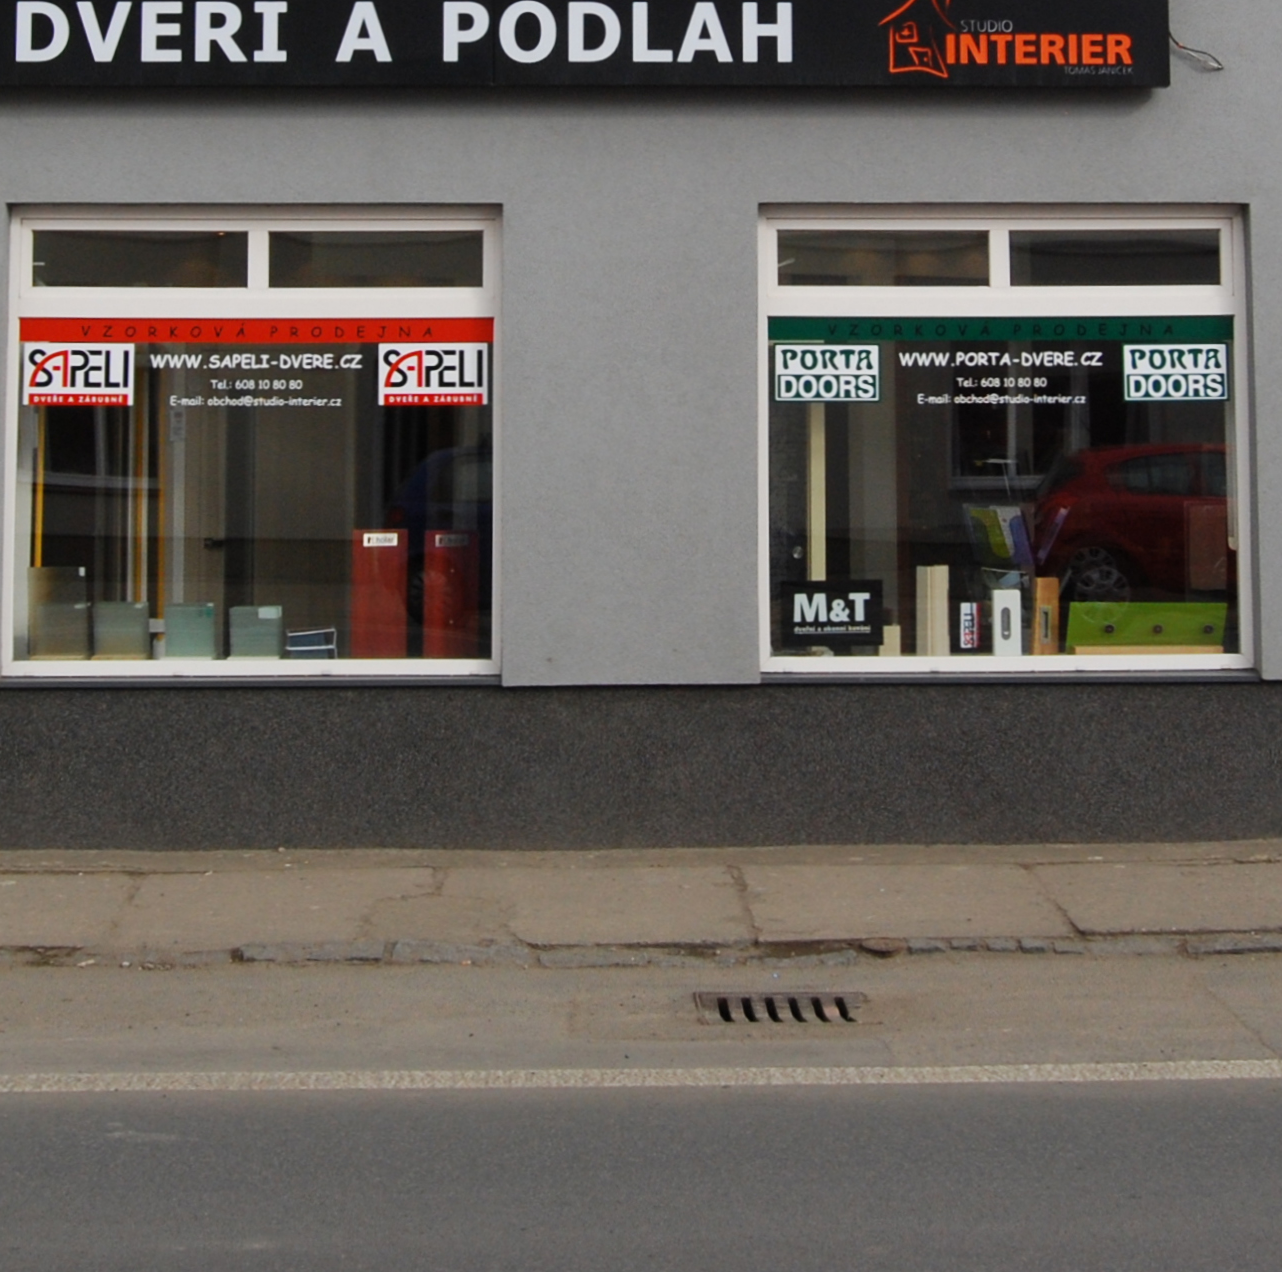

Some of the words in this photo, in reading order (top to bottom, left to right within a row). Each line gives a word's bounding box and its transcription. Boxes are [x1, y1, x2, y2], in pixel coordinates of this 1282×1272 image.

[335, 1, 392, 64] A
[443, 1, 794, 64] PODLAH
[960, 19, 1013, 33] STUDIO
[946, 34, 1133, 65] INTERIER
[80, 322, 247, 338] VZORKOVÁ
[270, 325, 434, 338] PRODEJNA
[828, 321, 991, 336] VZORKOVÁ
[1013, 324, 1175, 336] PRODEJNA
[150, 354, 363, 370] WWW.SAPELI-DVERE.CZ
[780, 347, 875, 370] PORTA
[899, 351, 1104, 367] WWW.PORTA-DVERE.CZ
[1130, 348, 1222, 370] PORTA
[29, 349, 129, 388] SAPELI
[384, 349, 484, 388] SAPELI
[210, 379, 232, 390] Tel.:
[235, 379, 256, 390] 608
[258, 379, 271, 390] 10
[272, 379, 287, 390] 80
[288, 379, 303, 390] 80
[779, 375, 875, 398] DOORS
[956, 377, 978, 388] Tel.:
[980, 377, 1001, 388] 608
[1003, 377, 1016, 388] 10
[1017, 377, 1032, 388] 80
[1033, 377, 1048, 388] 80
[1129, 375, 1224, 398] DOORS
[68, 395, 75, 403] A
[170, 396, 205, 407] E-mail:
[207, 396, 342, 408] obchod@studio-interier.cz
[423, 395, 430, 403] A
[917, 393, 951, 405] E-mail:
[954, 393, 1086, 405] obchod@studio-interier.cz
[793, 593, 870, 622] M&T
